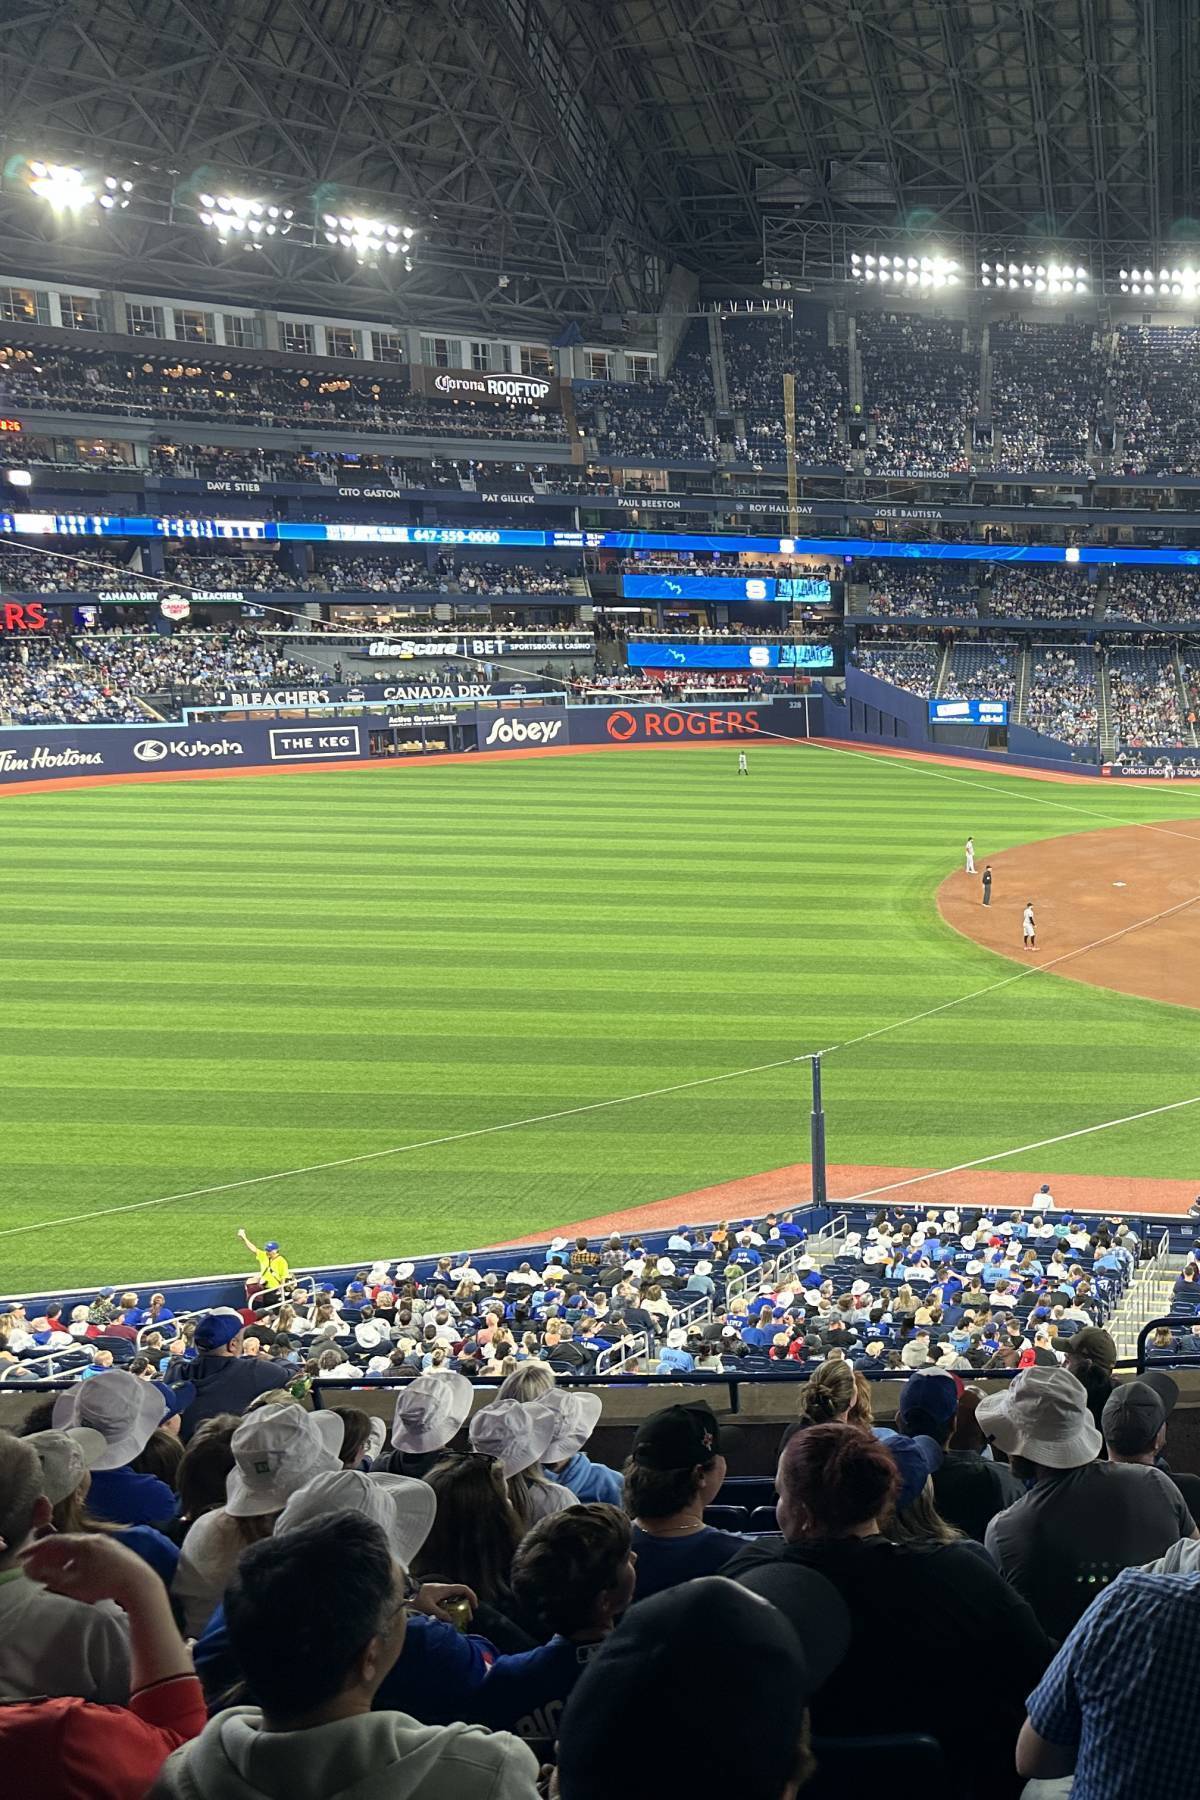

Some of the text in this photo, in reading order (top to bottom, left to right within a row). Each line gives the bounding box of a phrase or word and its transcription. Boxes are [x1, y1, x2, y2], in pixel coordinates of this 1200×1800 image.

[435, 375, 550, 398] Corona ROOFTOP
[505, 396, 533, 405] PATIO
[876, 468, 950, 479] JACKIE ROBINSON
[207, 481, 260, 492] DAVE STIEB
[338, 487, 400, 498] CITO GASTON
[481, 493, 535, 504] PAT GILLICK
[618, 499, 680, 509] PAUL BEESTON
[749, 504, 813, 514] ROY HALLADAY
[874, 507, 942, 519] JOSÉ BAUTISTA
[413, 529, 500, 543] 647-559-0060
[98, 591, 158, 601] CANADA DRY
[191, 591, 244, 601] BLEACHERS
[0, 602, 46, 630] RS
[369, 641, 458, 657] theScore
[472, 640, 506, 655] BET
[564, 642, 591, 650] CASINO
[231, 690, 330, 707] BLEACHERS
[383, 686, 453, 702] CANADA
[455, 684, 492, 698] DRY
[645, 710, 761, 736] ROGERS
[485, 717, 562, 745] Sobeys
[170, 739, 244, 756] Kubota
[280, 735, 350, 750] THE KEG
[31, 746, 104, 769] Hortons
[1121, 767, 1147, 775] Official
